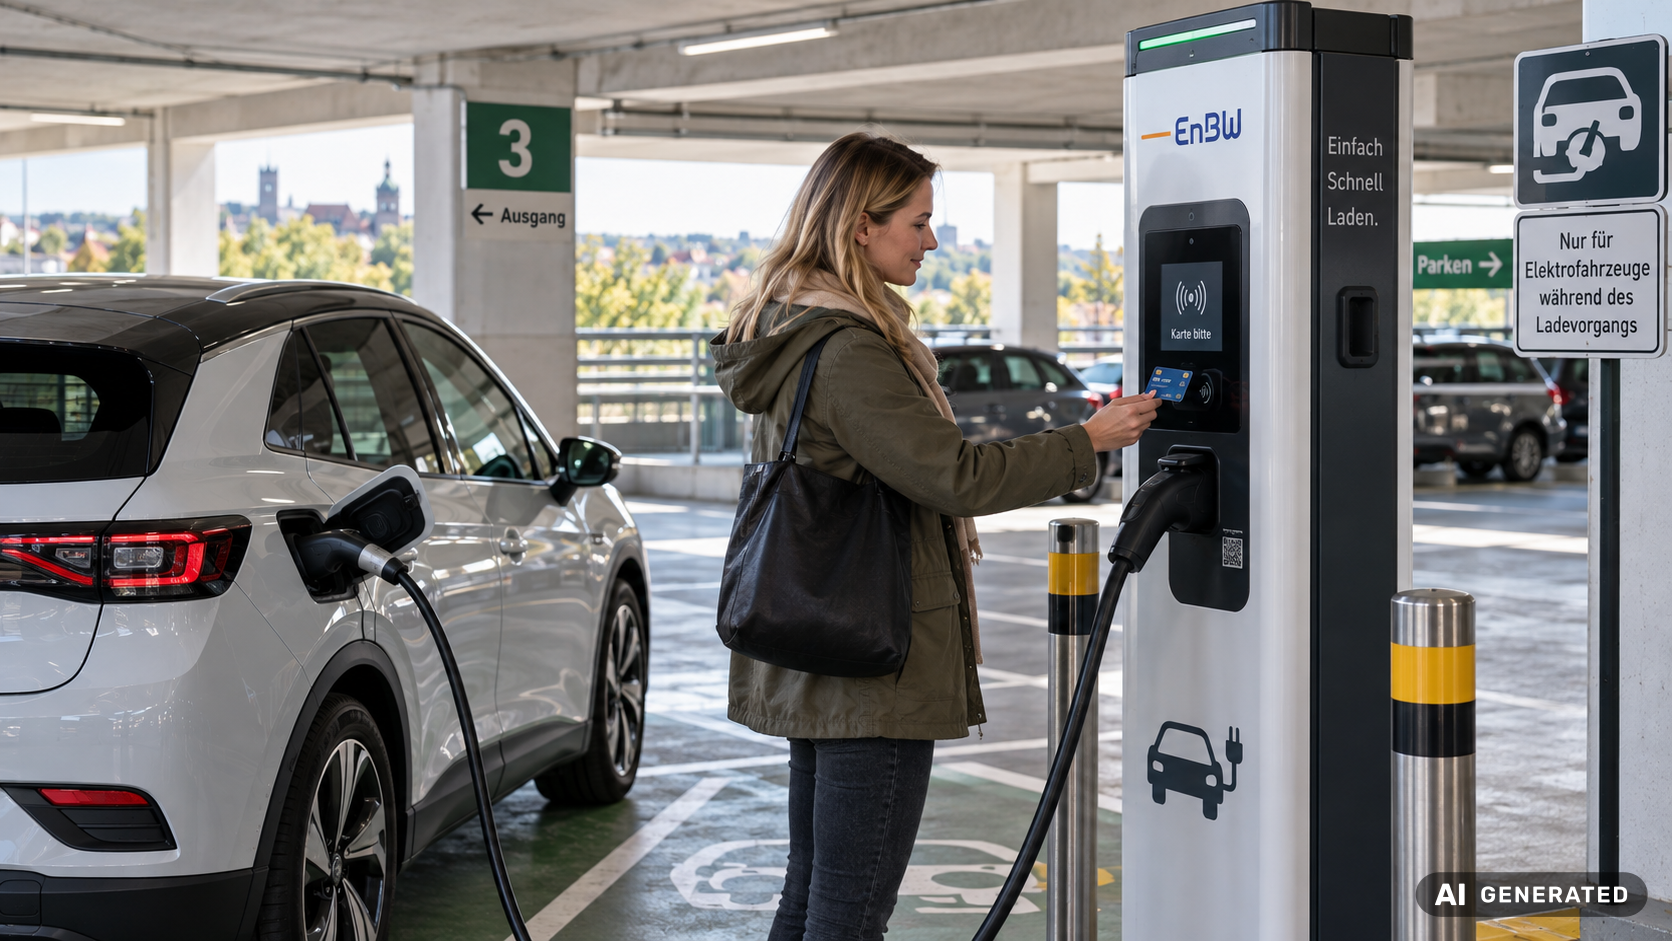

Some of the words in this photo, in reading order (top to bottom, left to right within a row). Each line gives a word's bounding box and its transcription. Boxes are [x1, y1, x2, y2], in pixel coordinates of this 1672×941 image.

[1174, 108, 1242, 146] EnBW
[498, 118, 533, 178] 3
[1328, 136, 1383, 157] Einfach
[1327, 171, 1384, 192] Schnell
[500, 207, 566, 229] Ausgang
[1327, 206, 1378, 226] Laden.
[1560, 232, 1587, 250] Nur
[1591, 230, 1614, 249] für
[1417, 254, 1473, 276] Parken
[1524, 259, 1651, 282] Elektrofahrzeuge
[1539, 287, 1602, 306] während
[1607, 286, 1634, 306] des
[1171, 328, 1192, 340] Karte
[1193, 328, 1212, 340] bitte
[1536, 315, 1638, 339] Ladevorgangs
